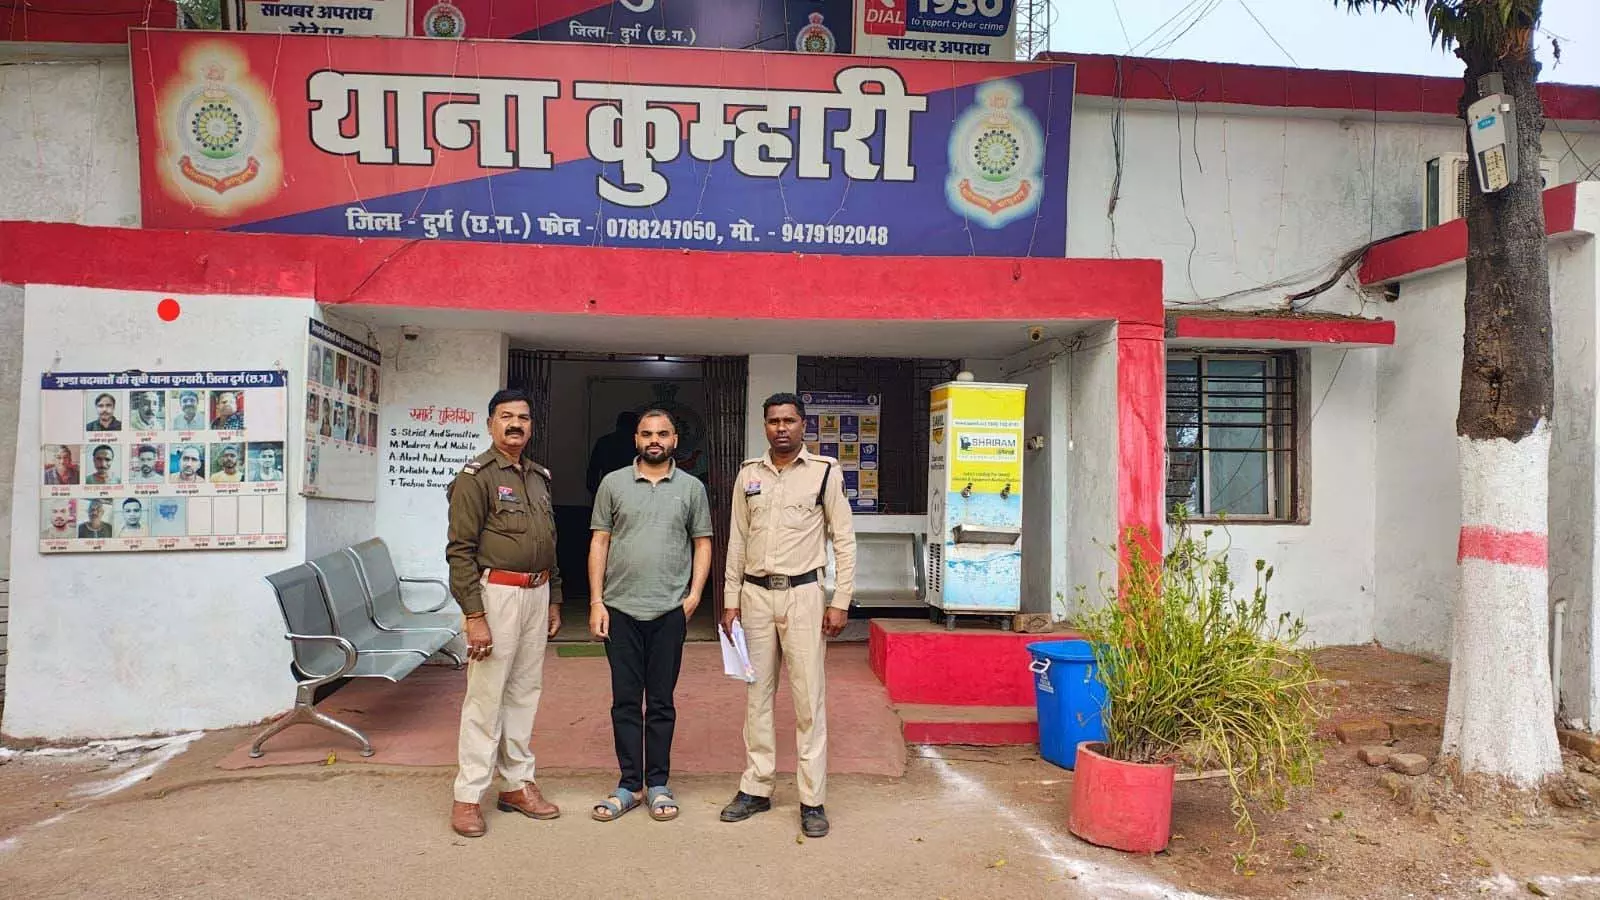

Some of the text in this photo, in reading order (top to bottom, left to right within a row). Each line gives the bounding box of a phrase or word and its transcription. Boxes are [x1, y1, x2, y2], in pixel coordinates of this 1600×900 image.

[261, 3, 373, 21] सायबर अपराध
[866, 9, 905, 25] DIAL
[911, 17, 1004, 31] to report cyber crime
[620, 24, 641, 44] दुर्ग
[888, 37, 992, 57] सायबर अपराध
[308, 65, 928, 207] थाना कुम्हारी
[345, 207, 402, 231] जिला
[421, 209, 454, 238] दुर्ग
[537, 213, 581, 236] फोन
[729, 219, 760, 242] मो.
[782, 223, 888, 245] 9479192048
[401, 428, 427, 437] Strict
[429, 429, 445, 438] And
[434, 441, 448, 450] And
[450, 441, 476, 450] Mobile
[971, 438, 1016, 448] SHRIRAM
[422, 453, 438, 462] And
[432, 467, 445, 476] And
